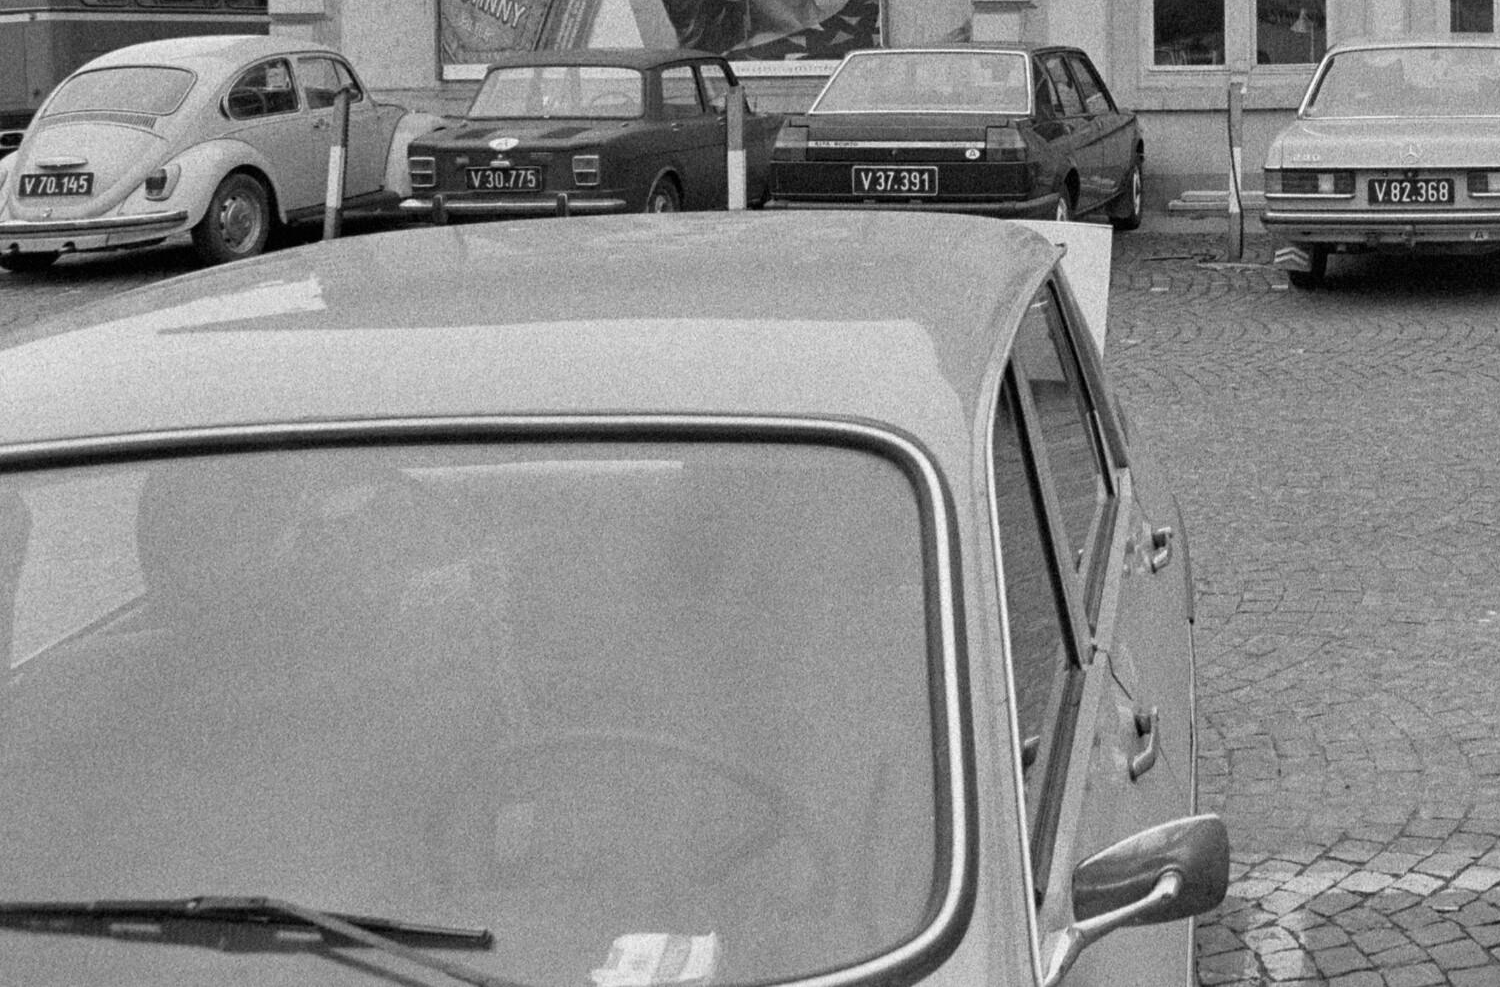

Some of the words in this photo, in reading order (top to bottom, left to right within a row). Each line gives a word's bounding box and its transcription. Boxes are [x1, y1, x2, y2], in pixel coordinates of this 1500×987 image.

[25, 177, 36, 195] V
[38, 175, 89, 194] 70.145
[471, 170, 482, 188] V
[485, 170, 536, 188] 30.775
[861, 171, 873, 191] V
[876, 171, 929, 191] 37.391
[1374, 181, 1387, 202] V
[1391, 181, 1449, 202] 82.368
